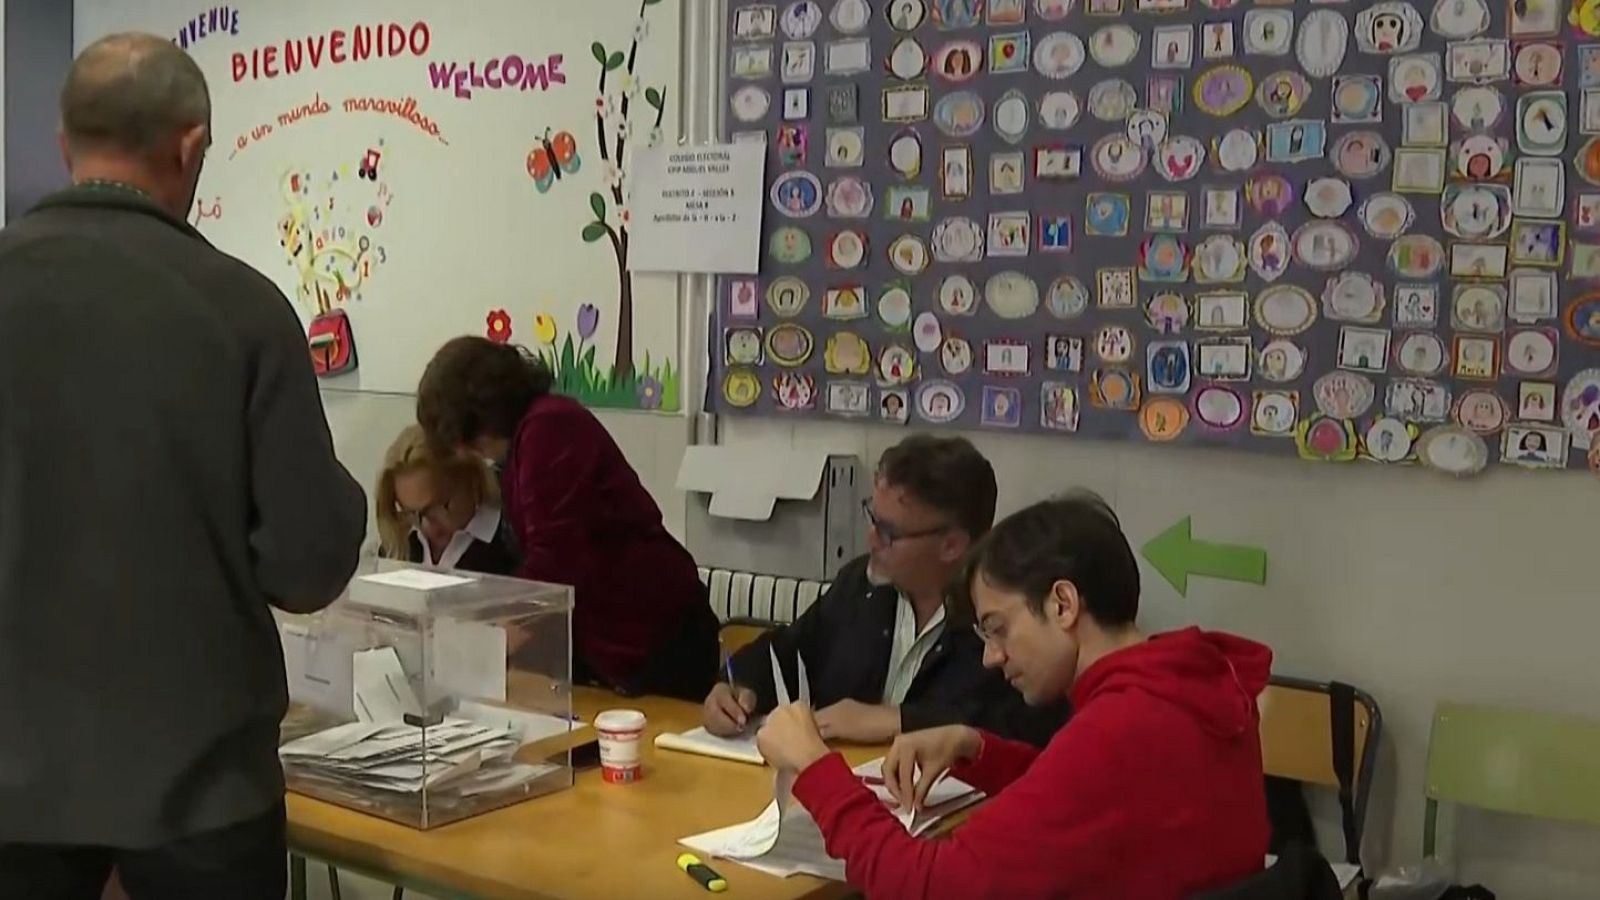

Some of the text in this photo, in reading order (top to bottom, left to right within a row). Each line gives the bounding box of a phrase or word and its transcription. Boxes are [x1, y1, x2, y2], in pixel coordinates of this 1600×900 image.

[231, 21, 430, 82] BIENVENIDO
[428, 53, 566, 100] WELCOME
[251, 123, 273, 141] un
[277, 92, 331, 127] mundo
